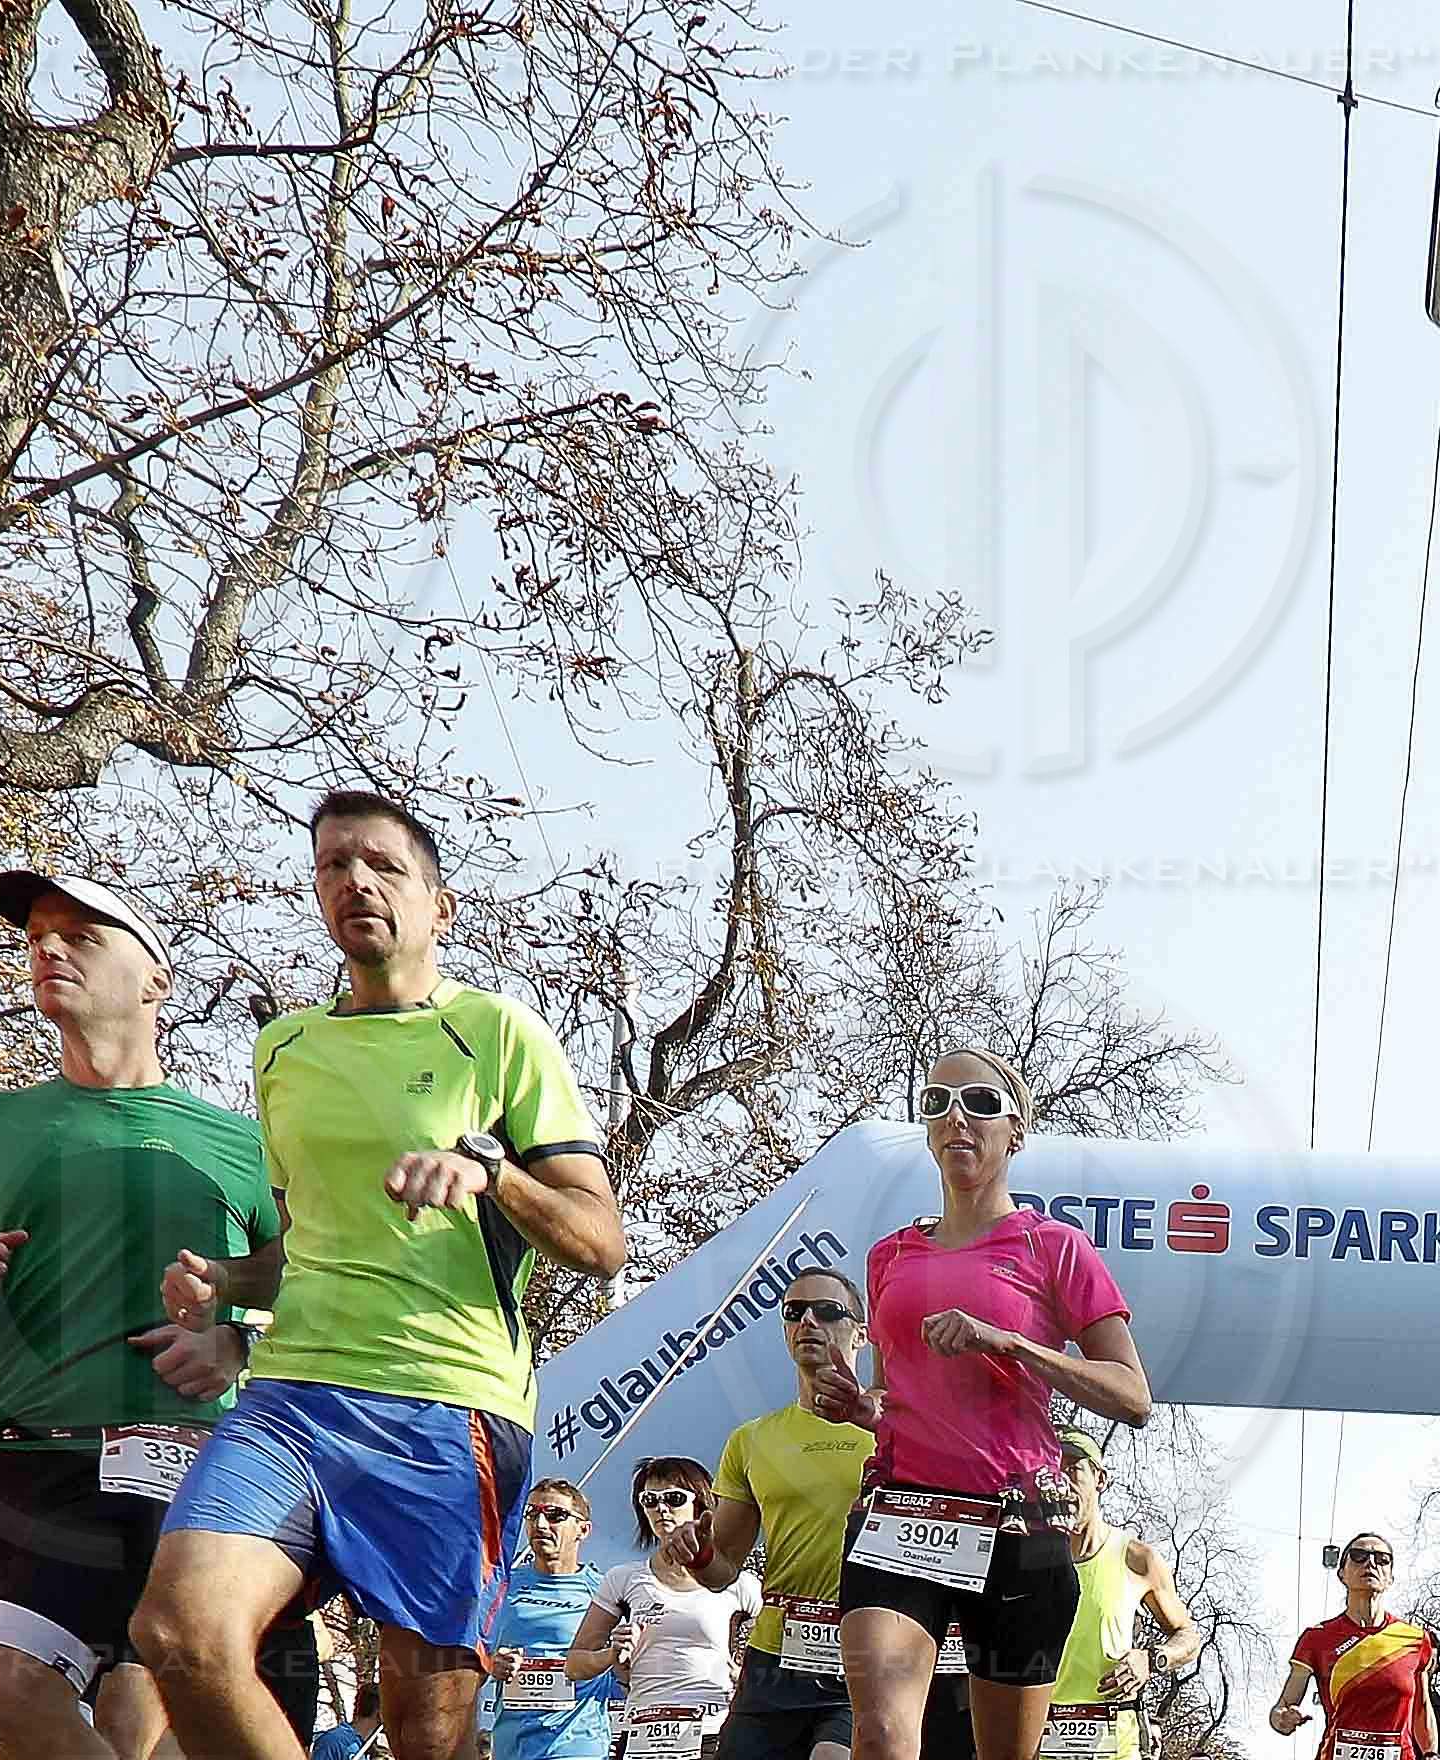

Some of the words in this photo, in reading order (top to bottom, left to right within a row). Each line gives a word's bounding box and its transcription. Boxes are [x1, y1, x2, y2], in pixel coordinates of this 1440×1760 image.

[546, 1229, 849, 1461] #glaubandich
[144, 1441, 200, 1465] 338
[902, 1495, 933, 1507] GRAZ
[897, 1522, 960, 1550] 3904
[902, 1550, 943, 1565] Daniela
[518, 1673, 554, 1686] 3969
[646, 1723, 681, 1737] 2614
[1060, 1722, 1097, 1736] 2925
[1350, 1746, 1386, 1760] 2736
